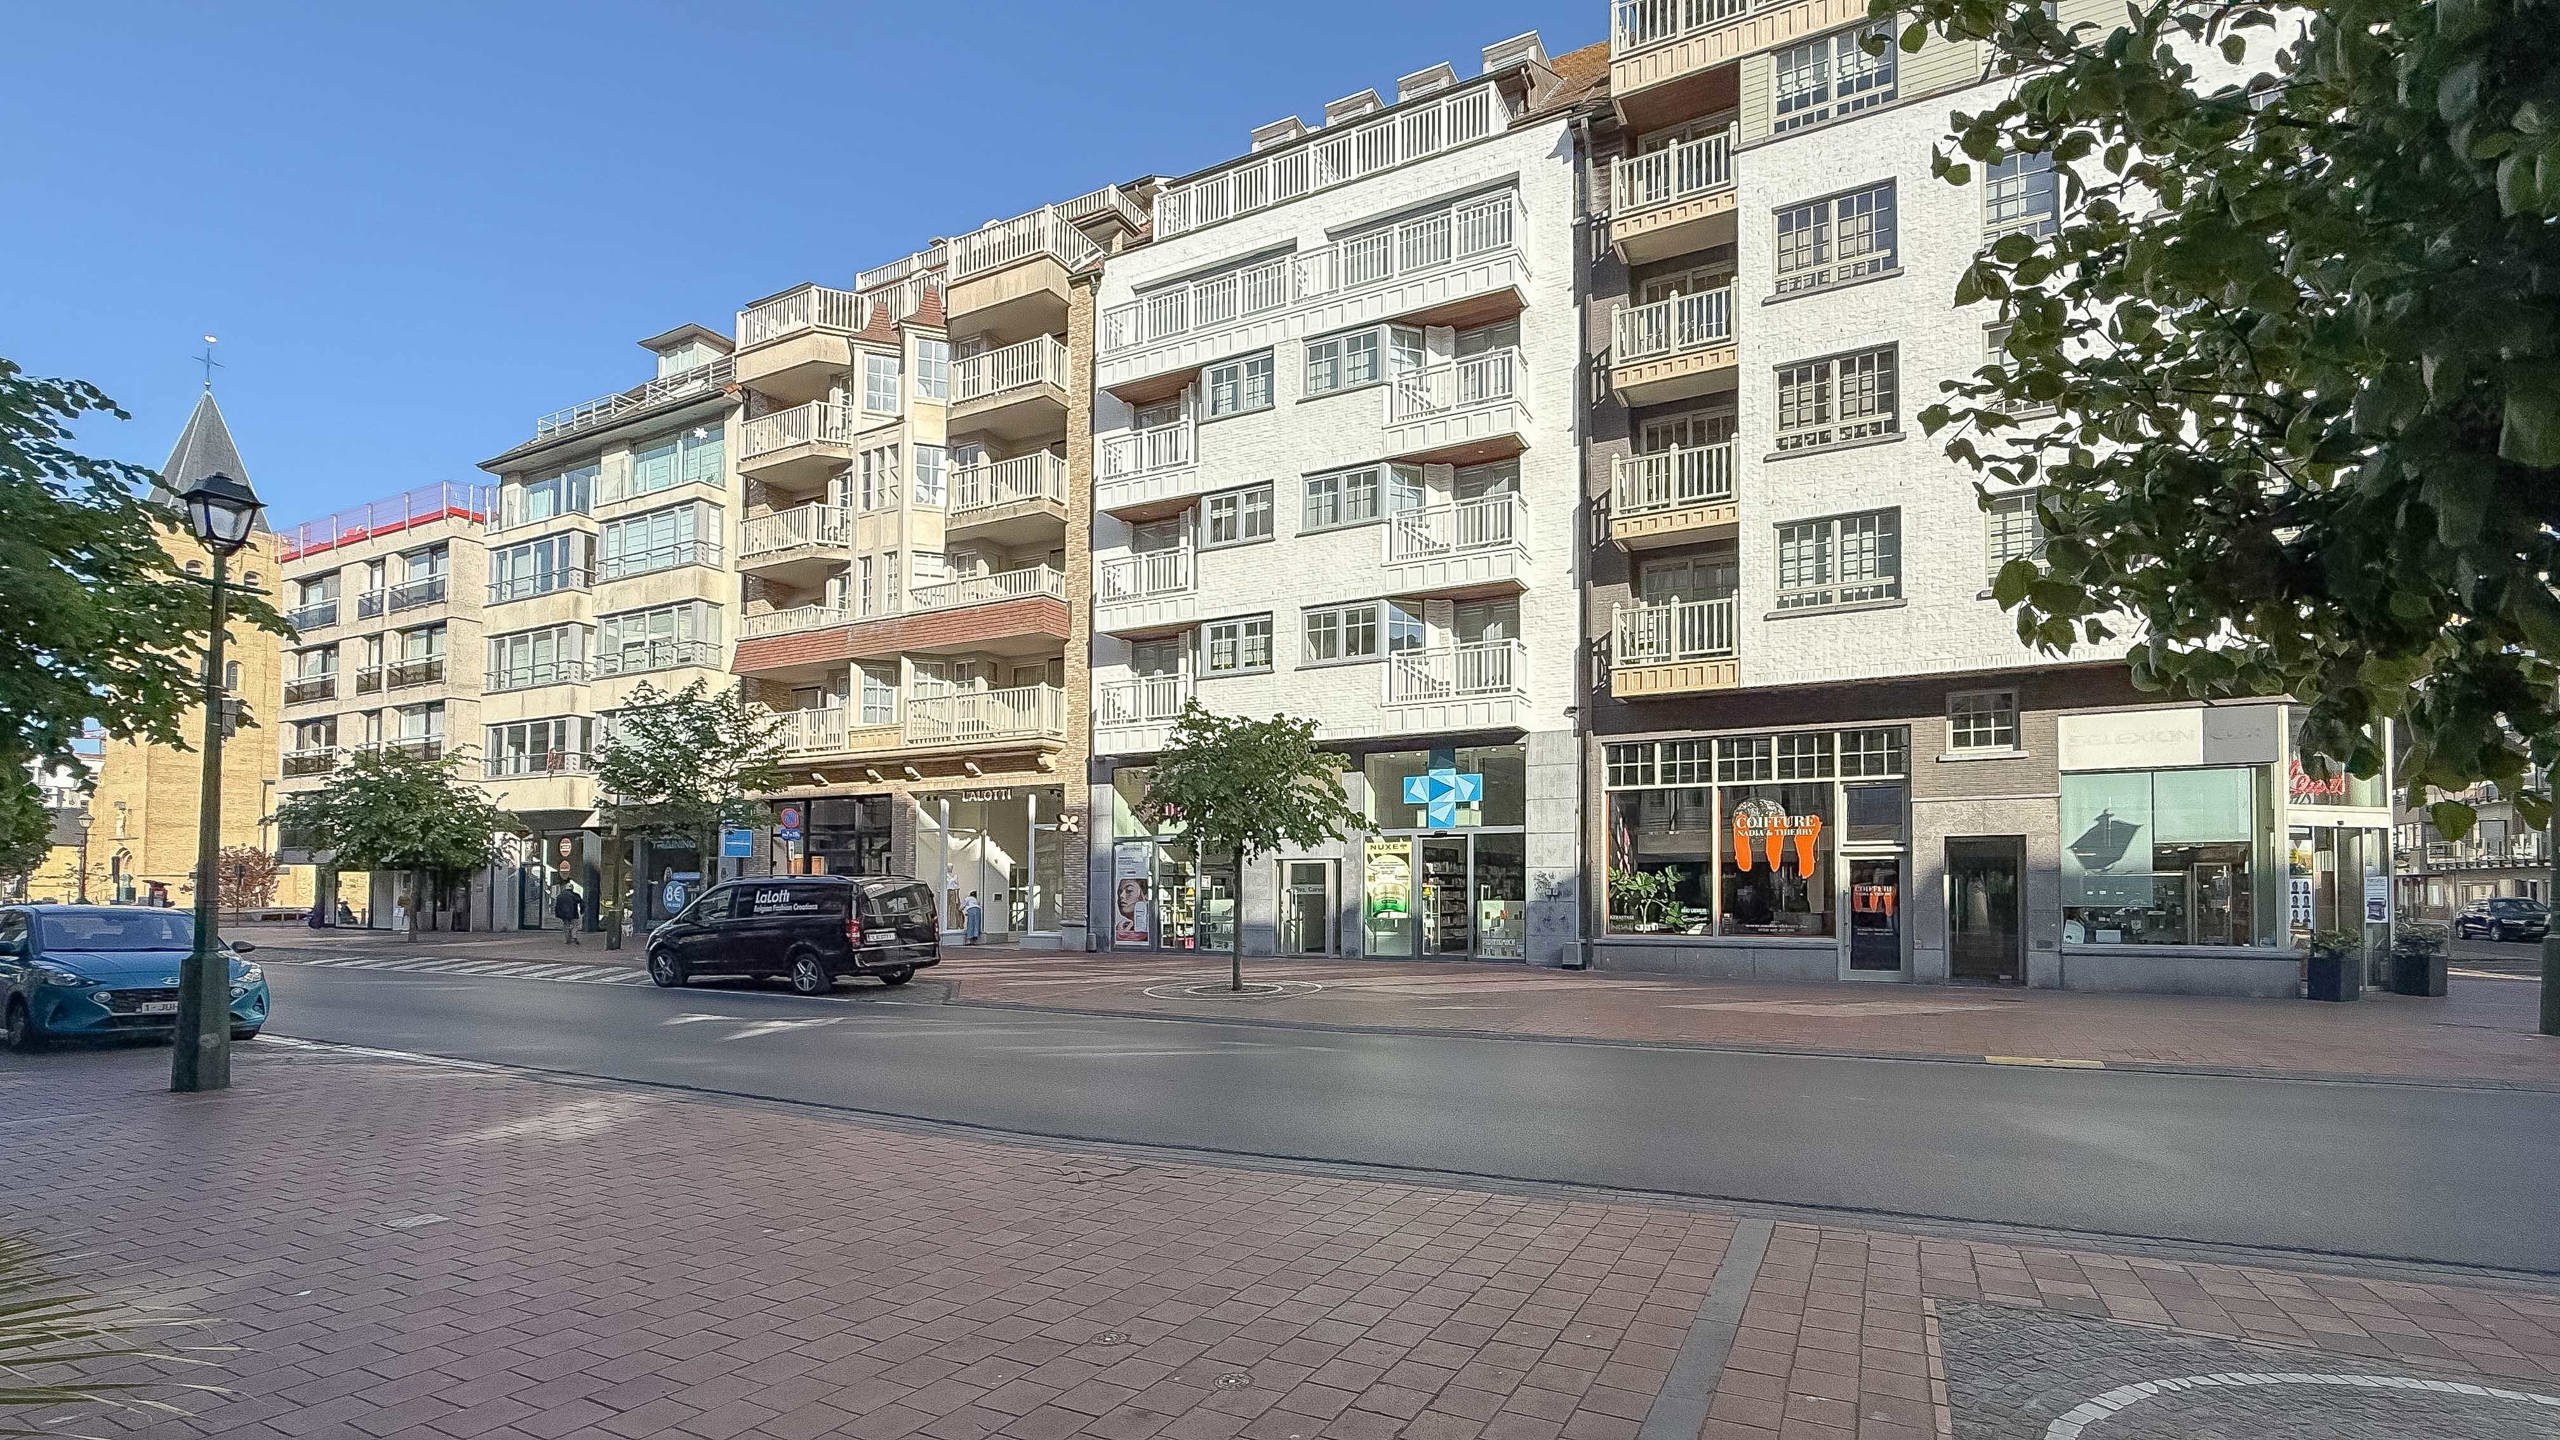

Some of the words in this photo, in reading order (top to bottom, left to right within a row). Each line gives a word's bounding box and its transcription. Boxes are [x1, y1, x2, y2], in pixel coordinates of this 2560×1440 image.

[961, 788, 1012, 802] LALOTTI
[1736, 815, 1816, 829] COIFFURE
[1737, 829, 1764, 837] NADIA
[1774, 828, 1814, 837] THIERRY
[665, 885, 682, 902] 8€
[755, 889, 790, 904] LaLotti
